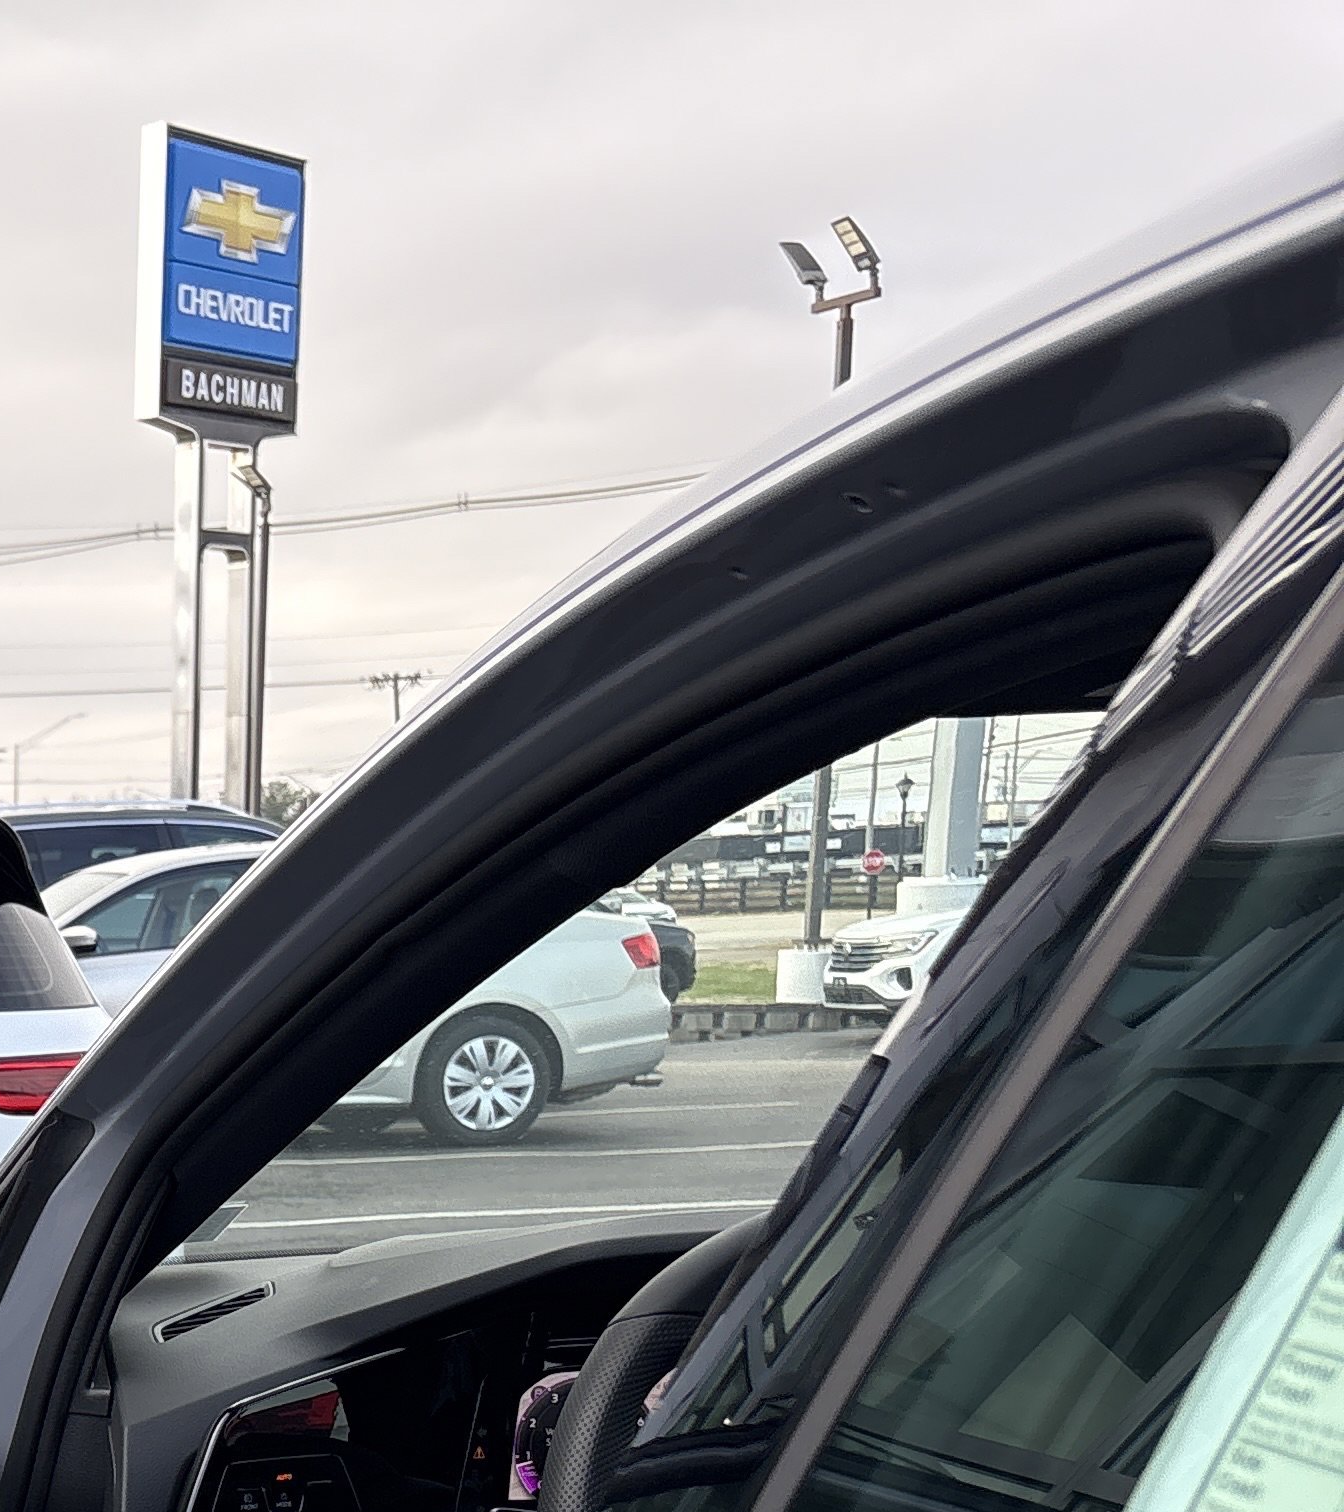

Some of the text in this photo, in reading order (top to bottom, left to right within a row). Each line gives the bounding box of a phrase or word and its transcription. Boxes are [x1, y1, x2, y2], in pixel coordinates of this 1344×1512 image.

[177, 283, 294, 333] CHEVROLET
[181, 369, 285, 413] BACHMAN
[551, 1393, 559, 1404] 3
[529, 1418, 537, 1429] 2
